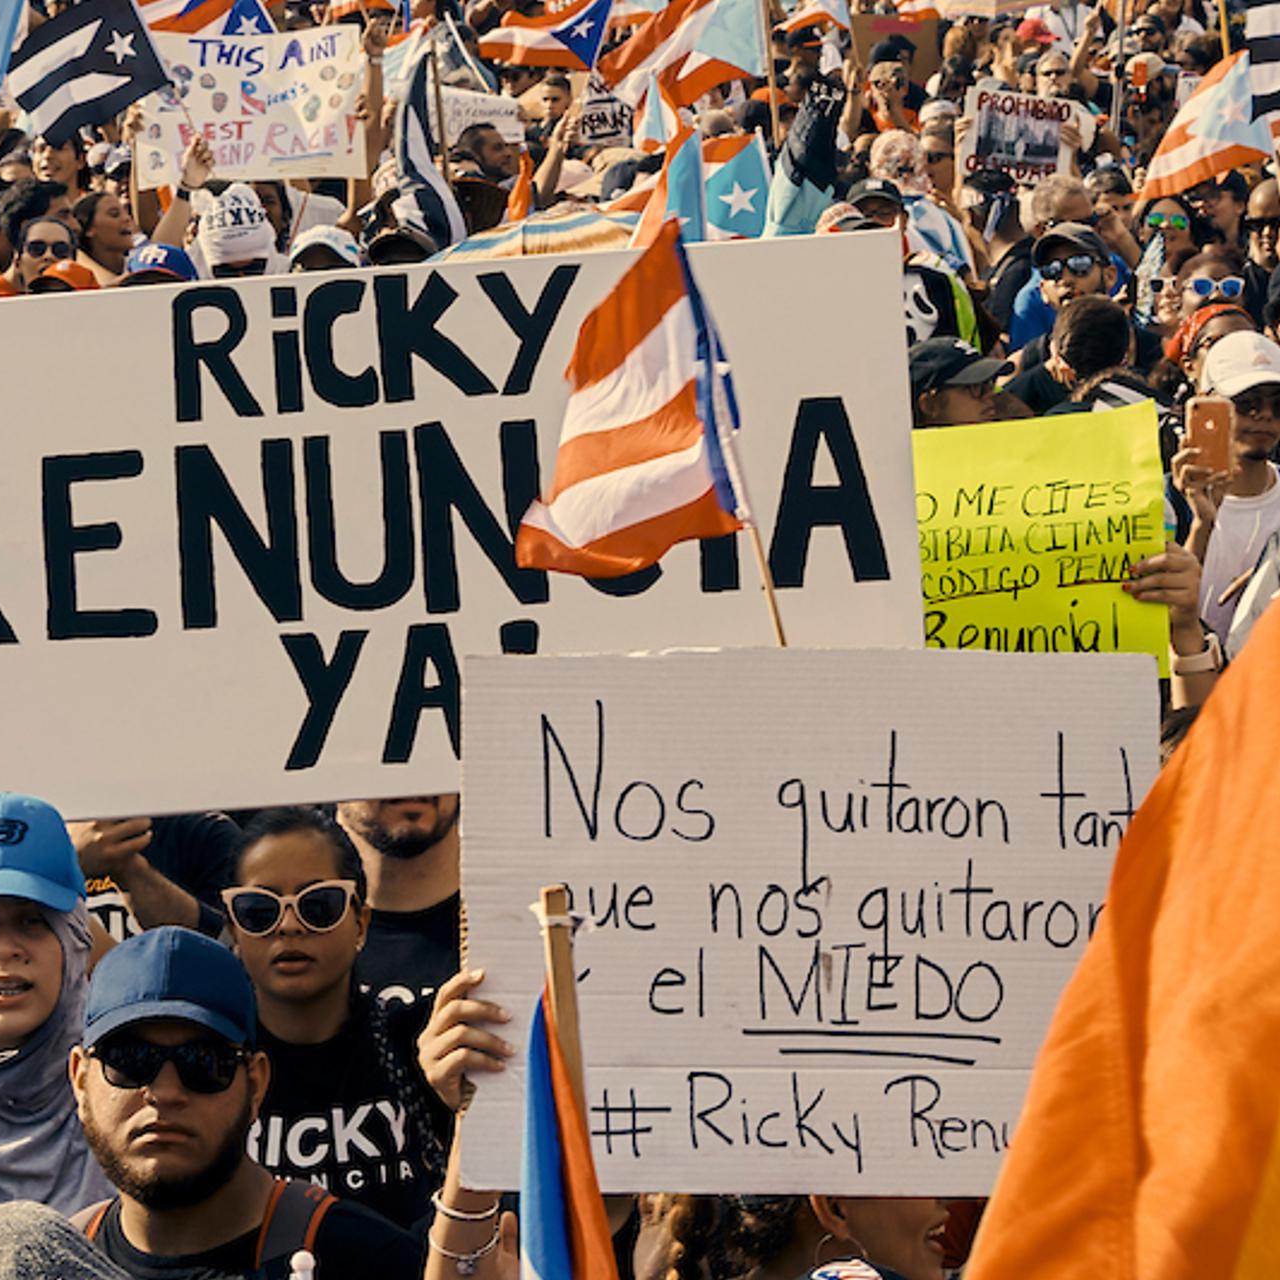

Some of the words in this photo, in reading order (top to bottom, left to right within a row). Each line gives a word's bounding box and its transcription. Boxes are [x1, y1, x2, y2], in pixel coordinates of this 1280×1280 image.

[188, 38, 265, 78] THIS
[278, 31, 342, 71] AINT
[953, 484, 1016, 518] ME
[1021, 479, 1133, 518] CITES
[1023, 513, 1155, 555] CITAME
[1056, 551, 1147, 587] PENA
[279, 619, 540, 772] YA
[540, 699, 716, 844] Nos
[776, 729, 1011, 893] quitaron
[711, 879, 824, 939] nos
[648, 947, 706, 1019] el
[758, 941, 1004, 1026] MIEDO
[275, 1159, 415, 1190] NCIA
